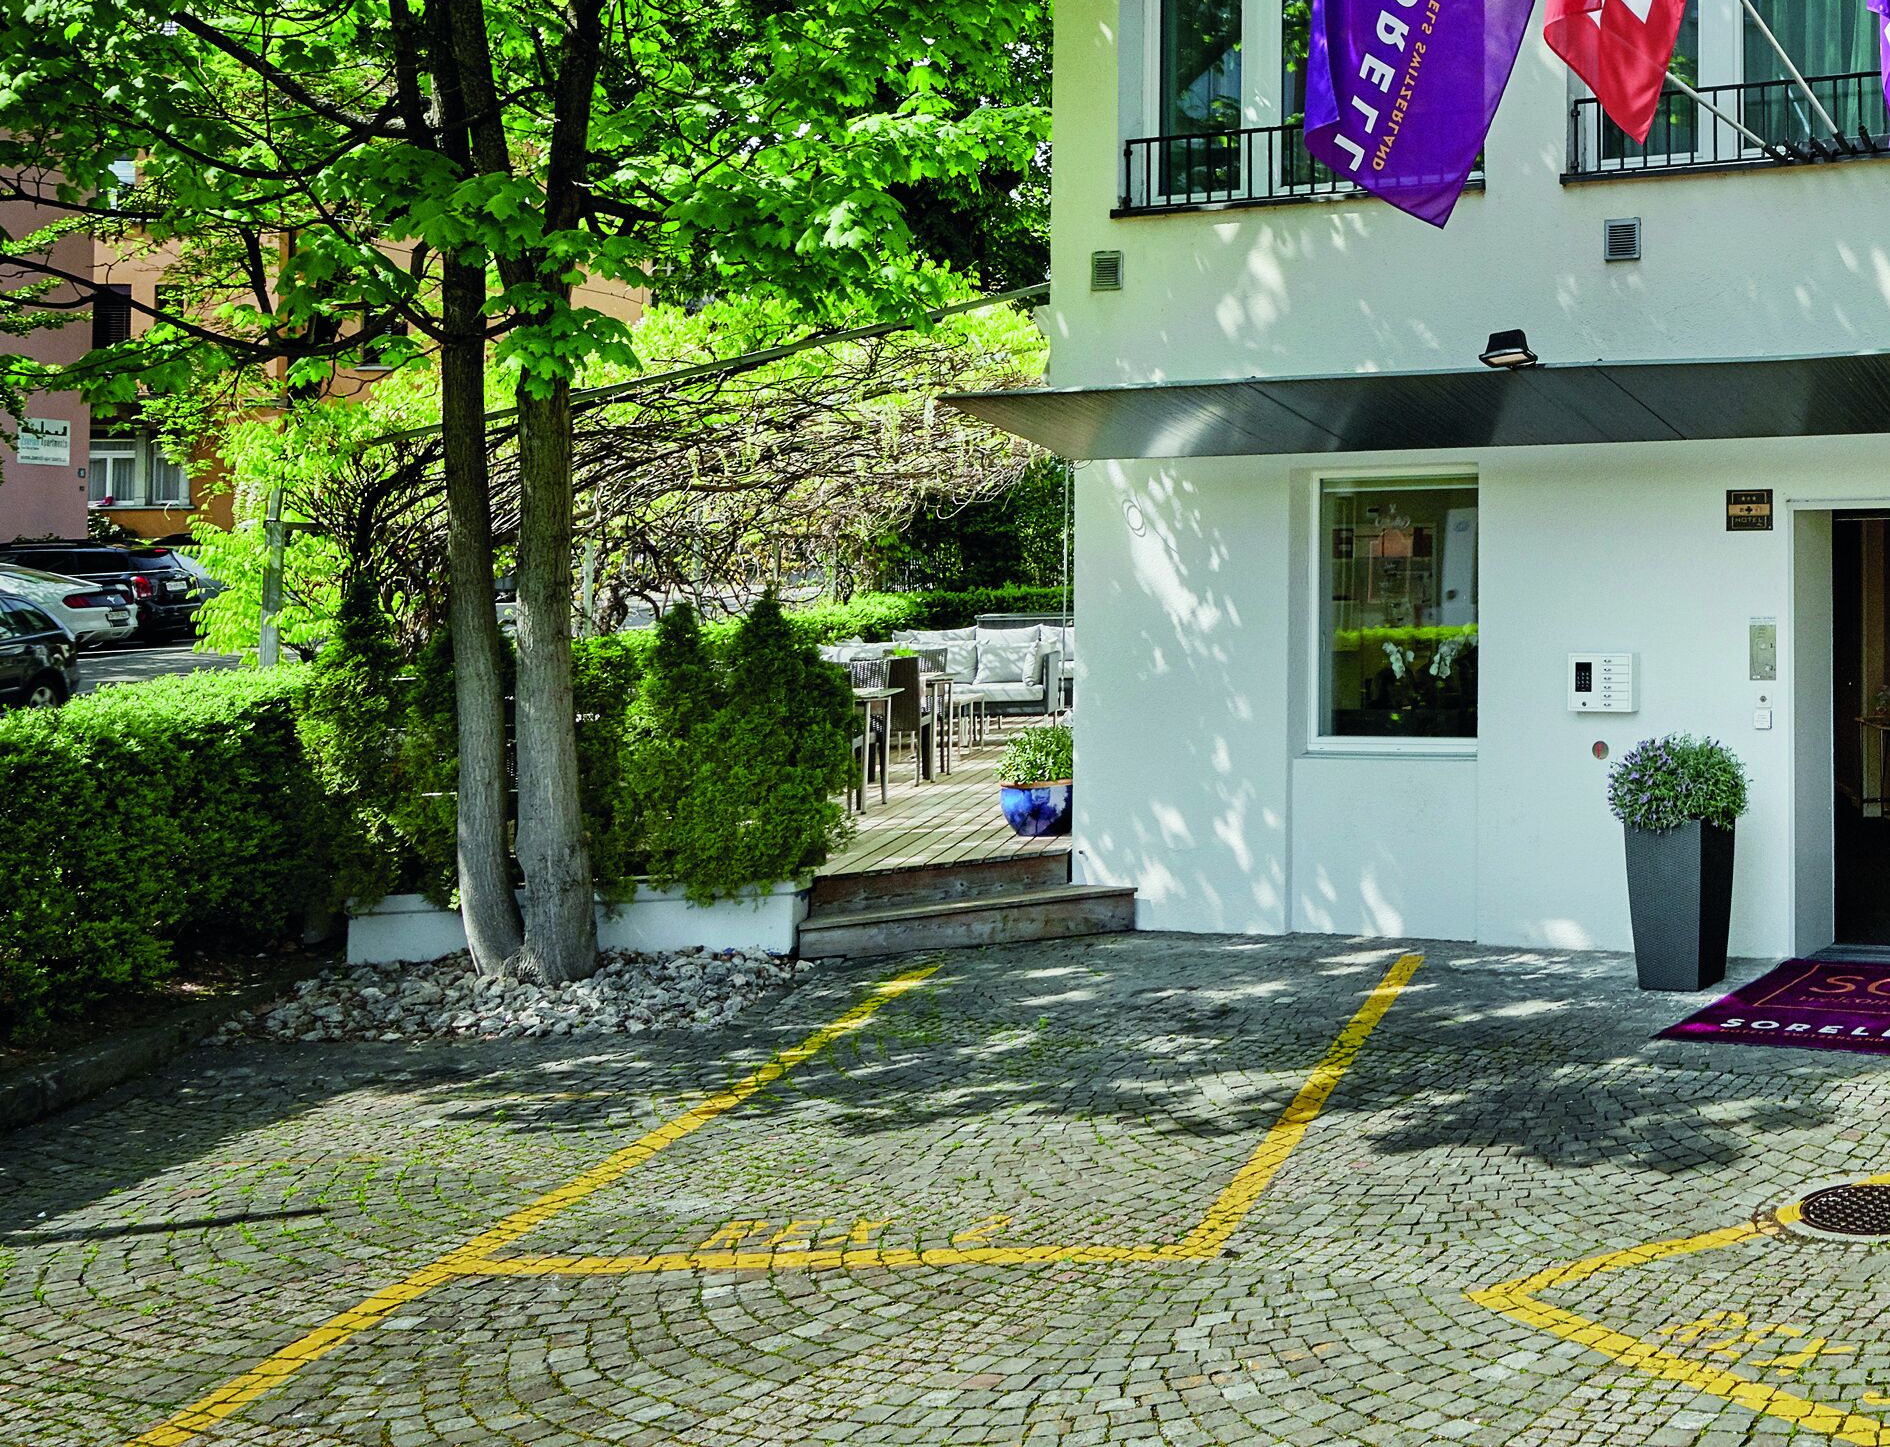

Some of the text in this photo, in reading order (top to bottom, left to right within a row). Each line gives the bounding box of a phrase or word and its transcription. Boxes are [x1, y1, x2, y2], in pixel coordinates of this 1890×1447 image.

[1720, 1028, 1886, 1043] HOTELS SWITZERLAND
[699, 1214, 1014, 1250] REX 2
